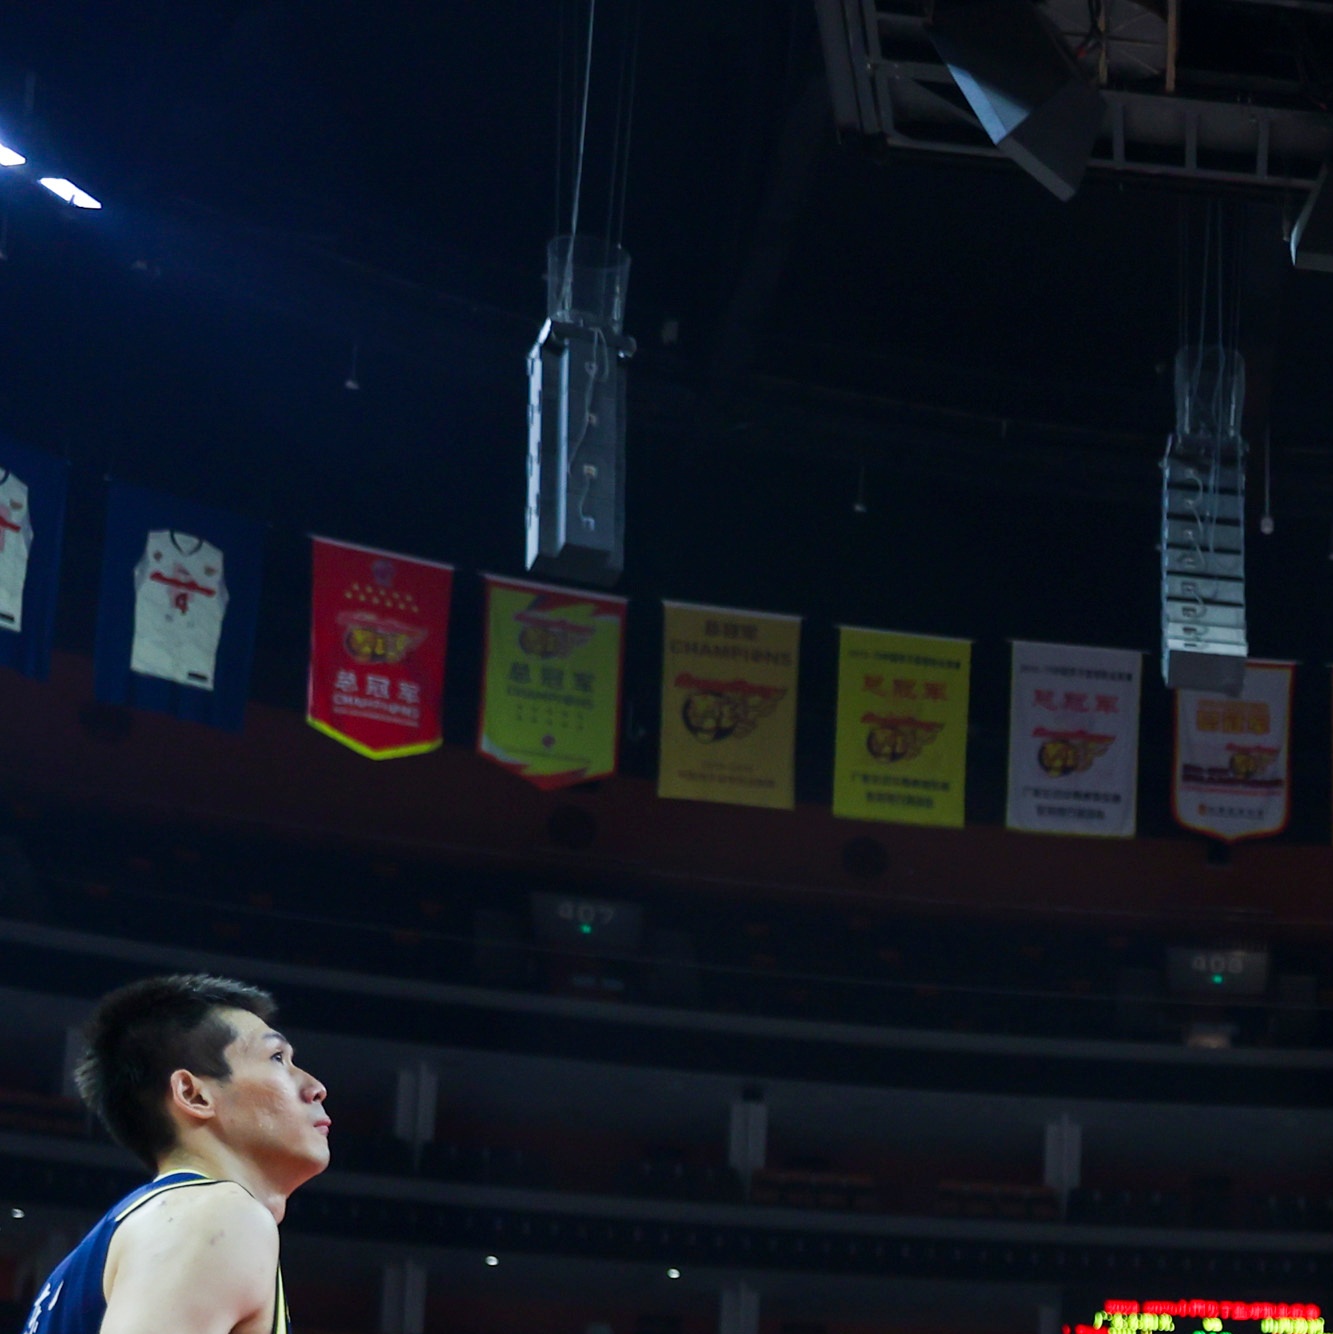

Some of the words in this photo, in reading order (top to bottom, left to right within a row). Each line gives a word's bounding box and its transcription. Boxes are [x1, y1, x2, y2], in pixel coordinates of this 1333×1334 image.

[668, 641, 792, 667] CHAMPIONS
[334, 669, 421, 704] 总冠军
